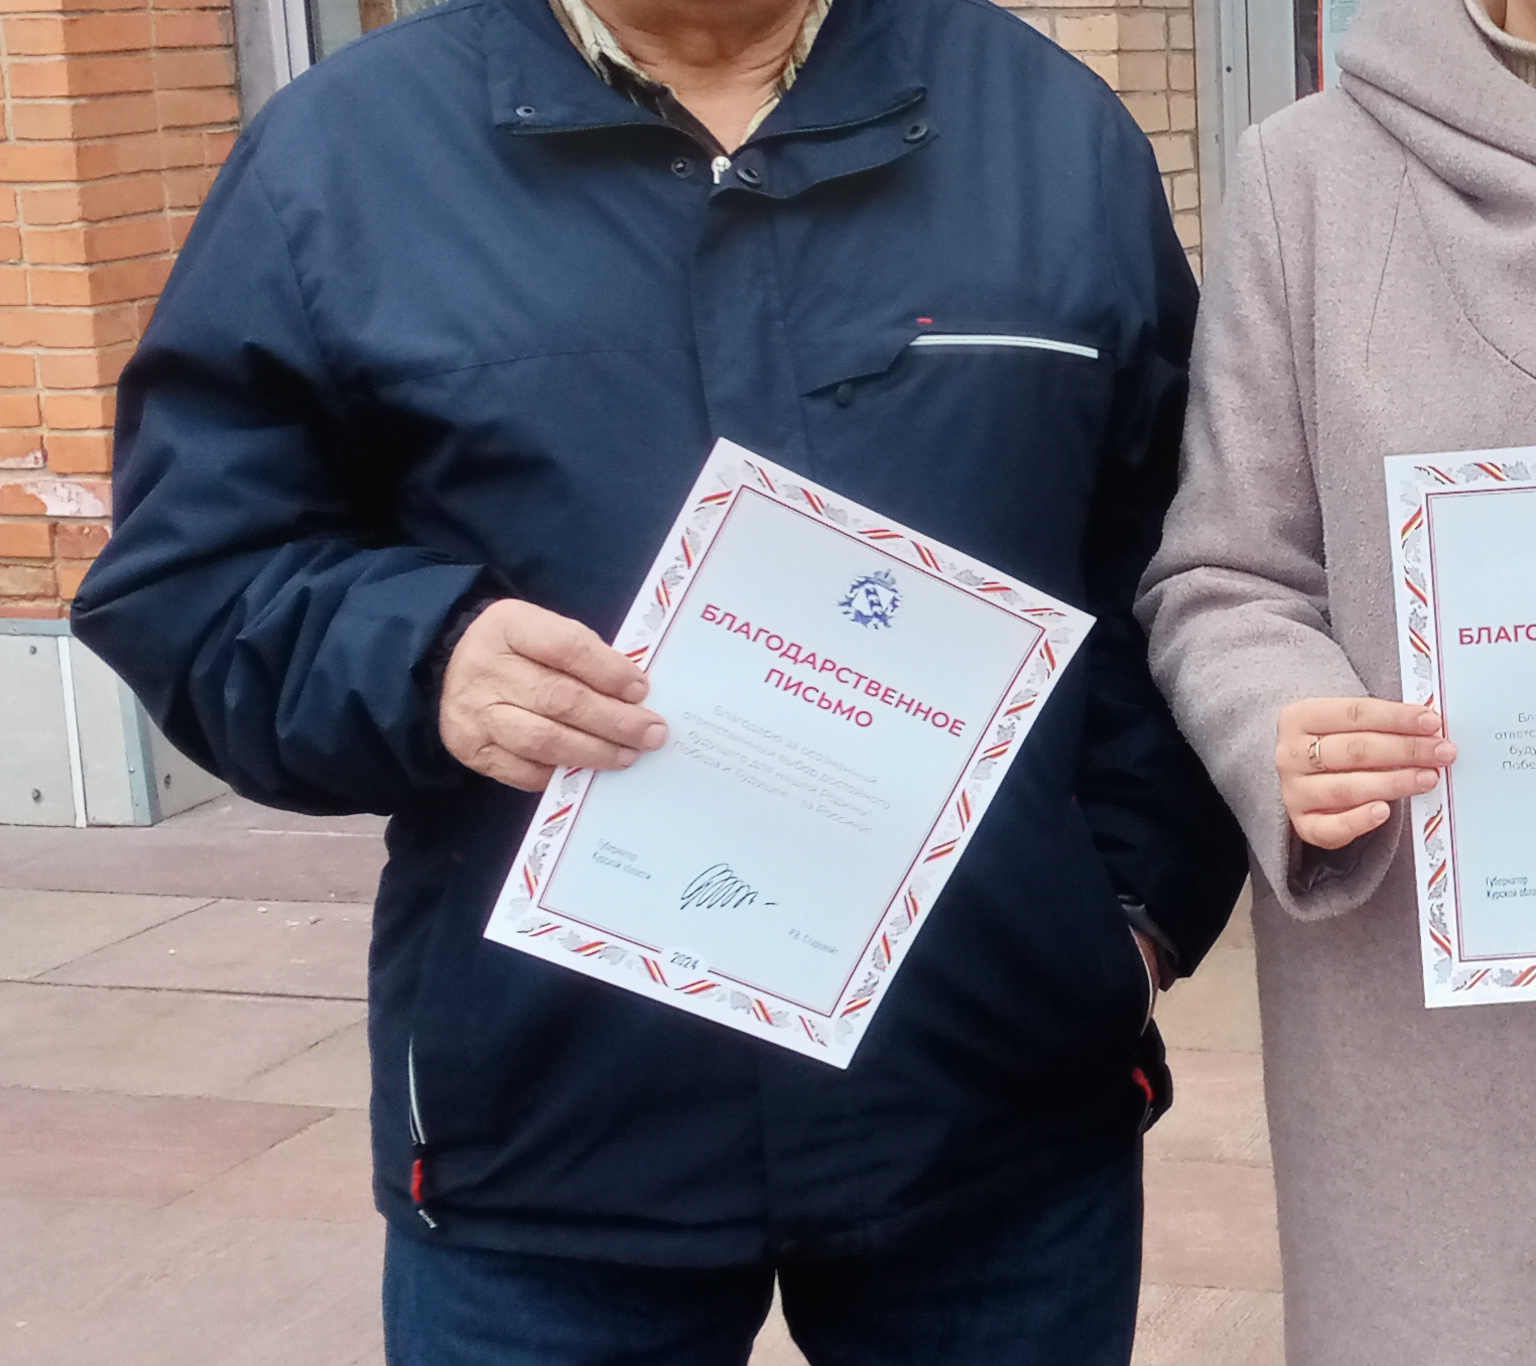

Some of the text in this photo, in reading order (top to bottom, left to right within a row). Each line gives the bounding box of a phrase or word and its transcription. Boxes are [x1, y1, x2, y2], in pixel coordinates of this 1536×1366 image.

[699, 603, 966, 739] БЛАГОДАРСТВЕННОЕ
[764, 667, 874, 730] ПИСЬМО
[669, 951, 700, 971] 2024
